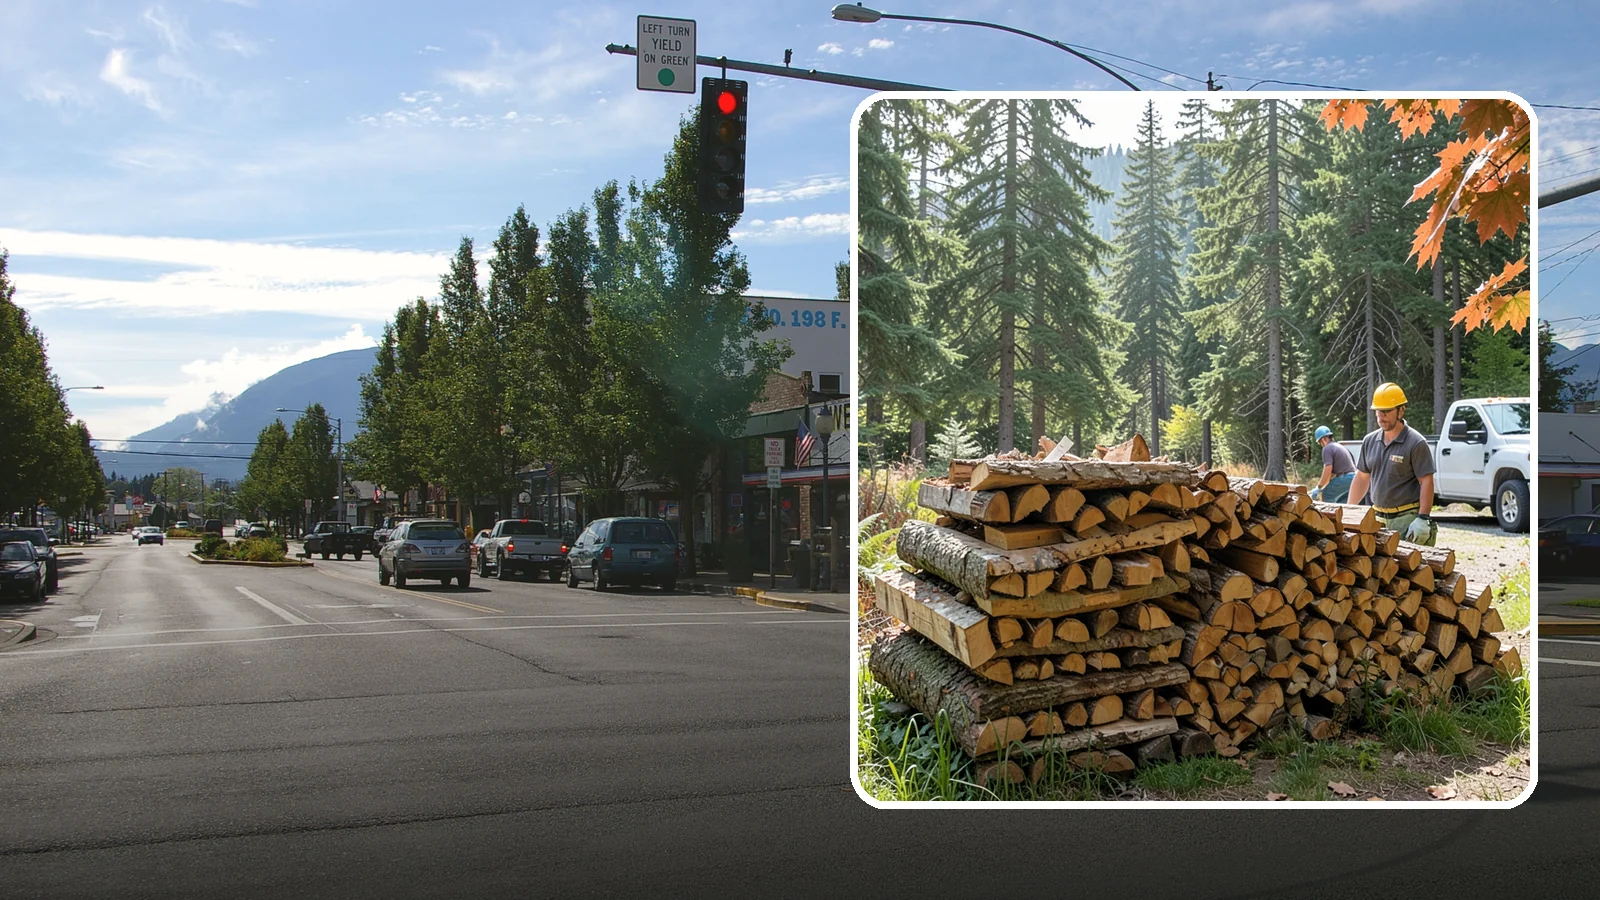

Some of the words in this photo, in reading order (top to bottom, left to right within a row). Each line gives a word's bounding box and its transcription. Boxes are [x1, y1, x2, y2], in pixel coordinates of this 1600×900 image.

[643, 24, 663, 34] LEFT
[668, 26, 690, 36] TURN
[652, 38, 682, 51] YIELD
[644, 53, 656, 63] ON
[661, 55, 689, 66] GREEN
[791, 309, 826, 328] 198
[831, 311, 847, 329] F.
